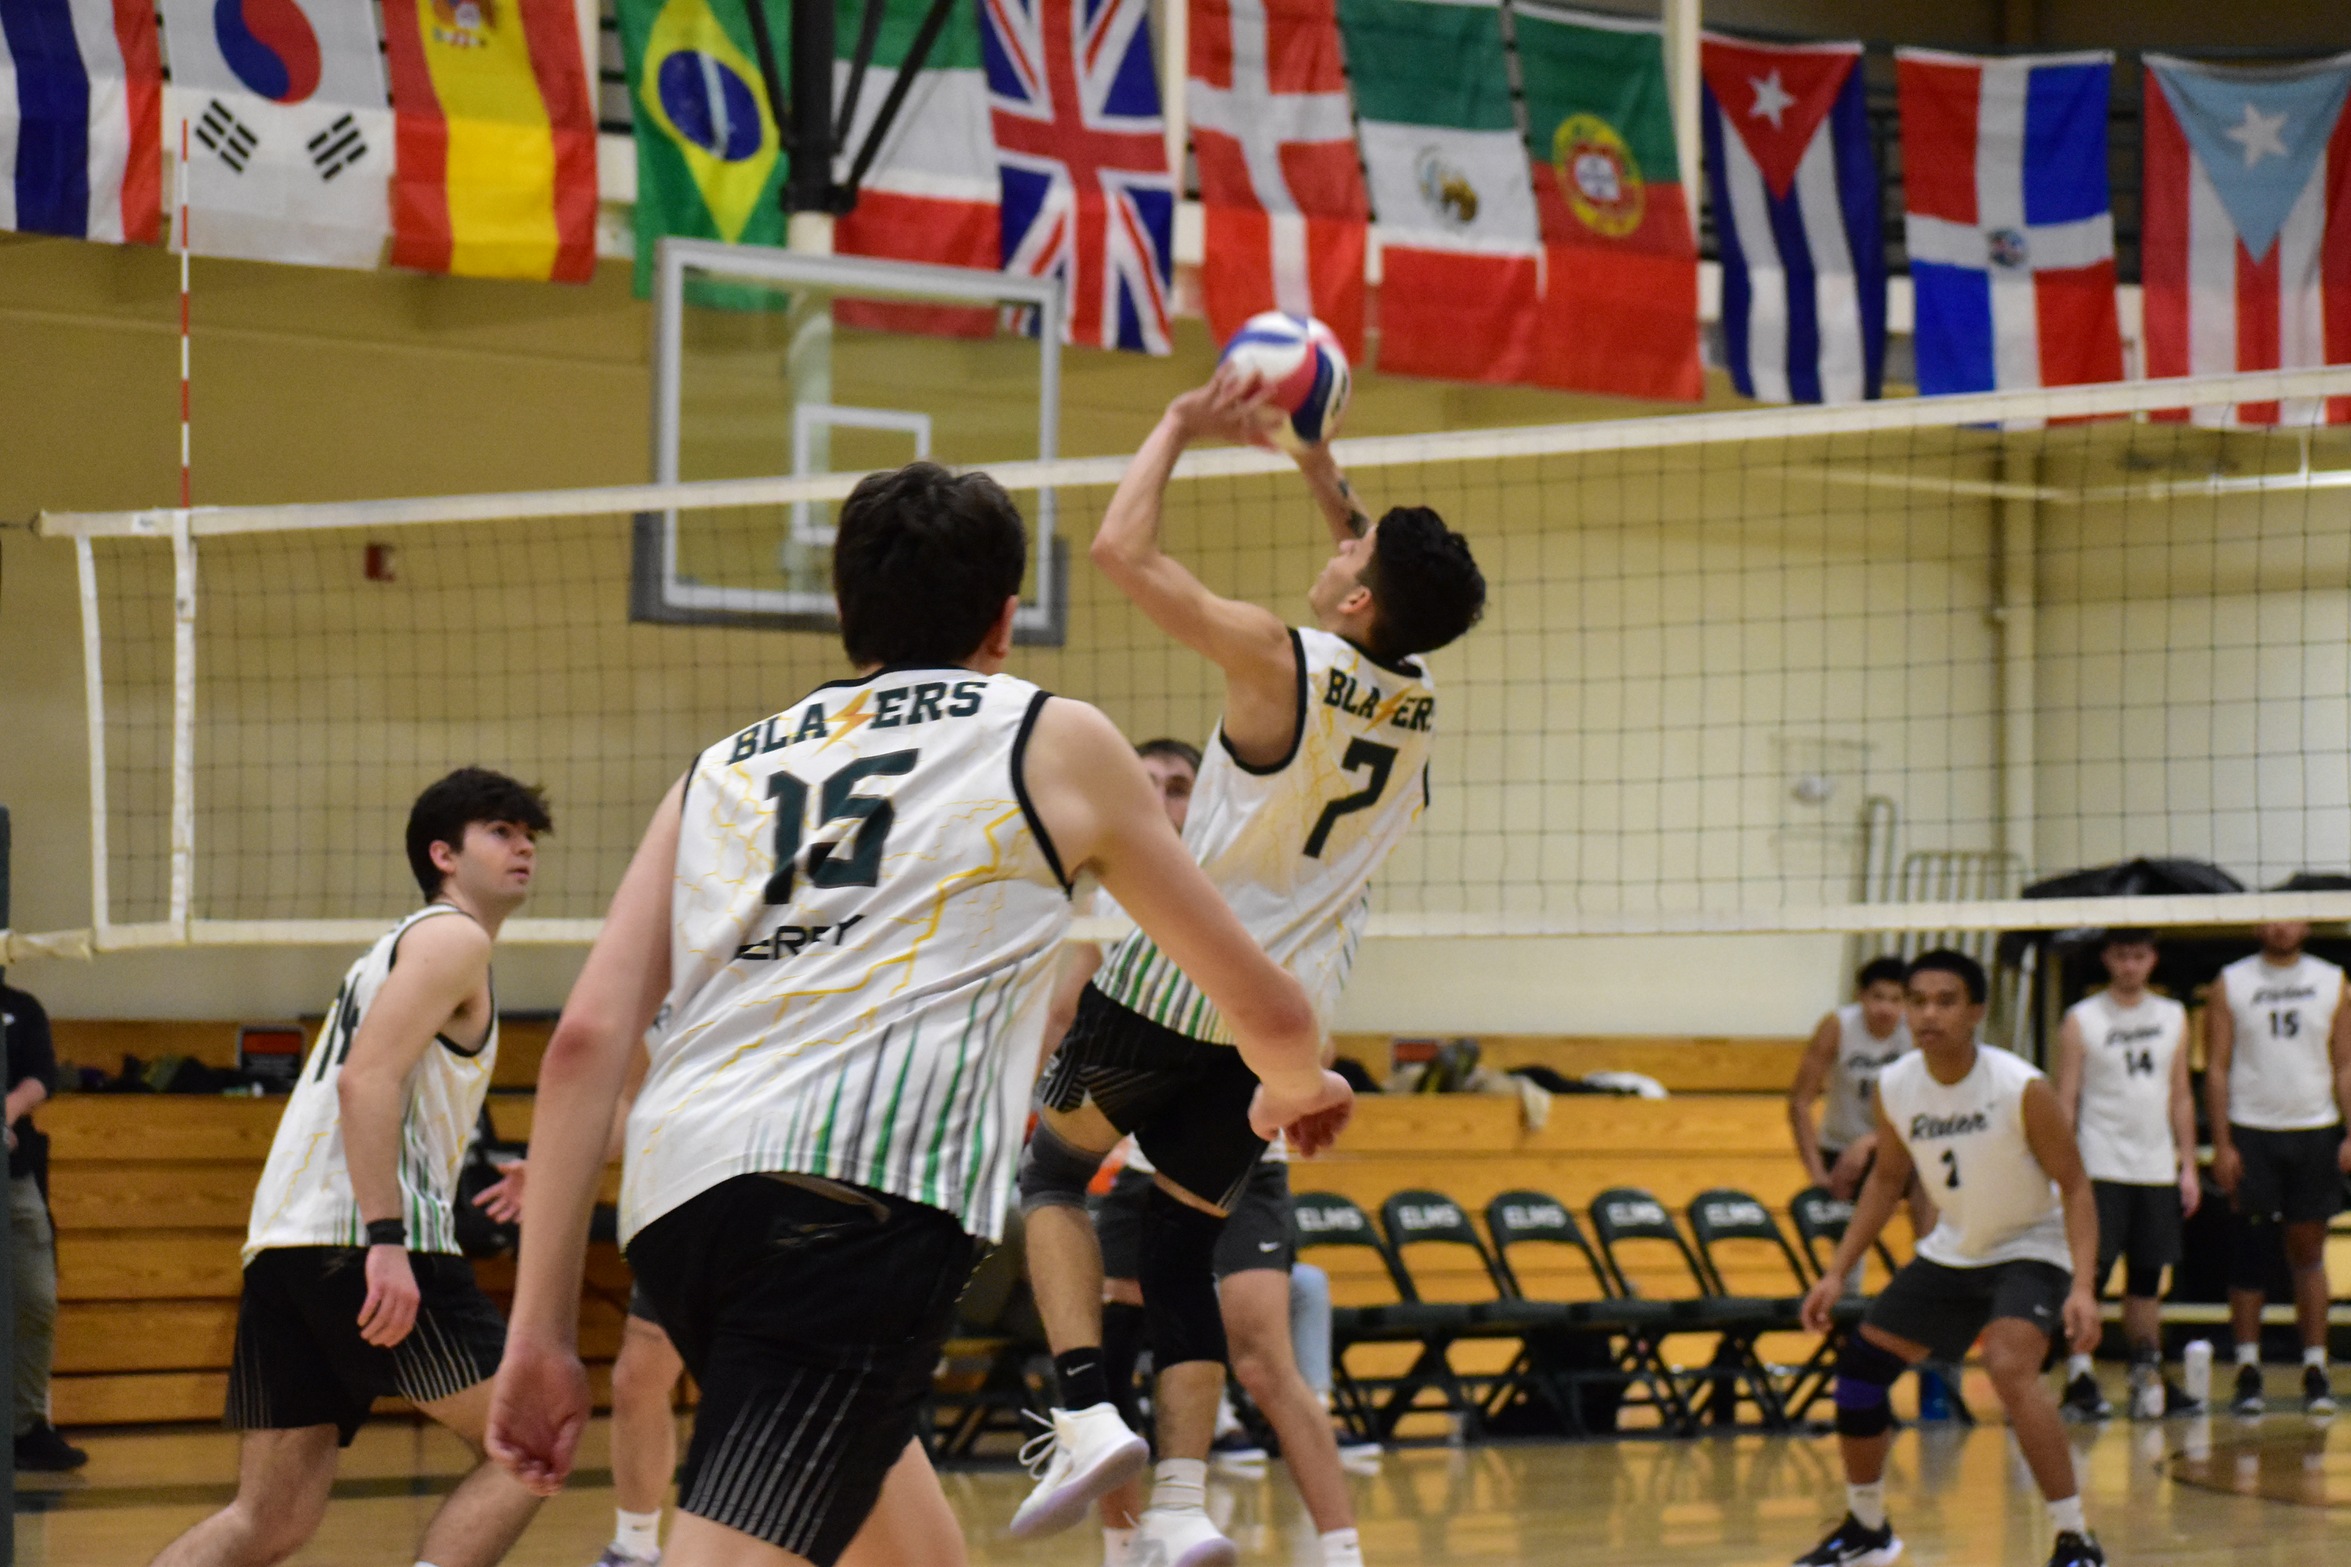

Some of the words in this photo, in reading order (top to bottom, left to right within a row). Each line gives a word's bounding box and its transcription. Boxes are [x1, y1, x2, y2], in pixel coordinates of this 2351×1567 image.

[1303, 735, 1400, 858] 7
[763, 747, 921, 905] 15
[2268, 1008, 2300, 1040] 15
[2124, 1048, 2155, 1078] 14
[1295, 1206, 1364, 1232] ELMS
[1398, 1203, 1462, 1230] ELMS
[1502, 1204, 1567, 1229] ELMS
[1606, 1202, 1666, 1227] ELMS
[1704, 1202, 1767, 1227] ELMS
